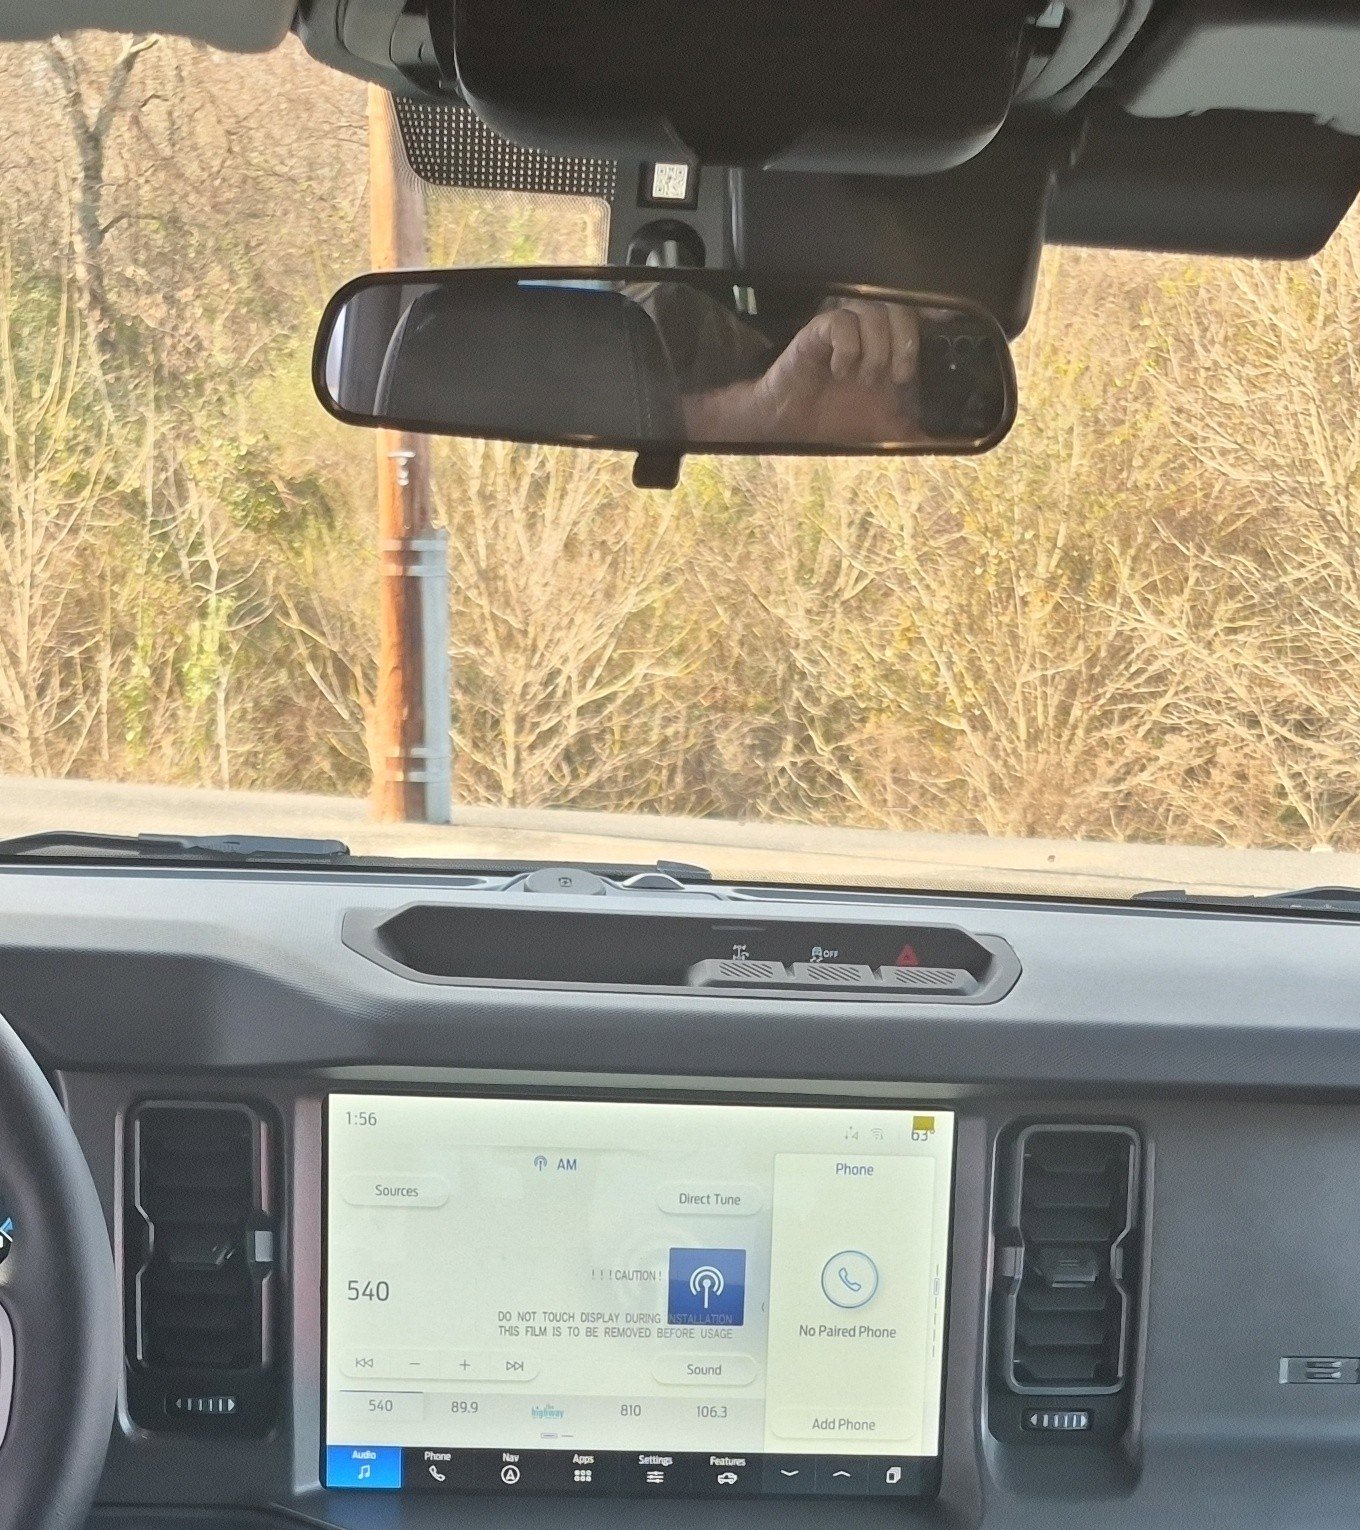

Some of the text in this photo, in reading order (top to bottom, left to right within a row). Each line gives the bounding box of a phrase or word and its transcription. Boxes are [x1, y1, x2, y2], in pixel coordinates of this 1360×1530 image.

[823, 950, 838, 958] OFF
[346, 1111, 377, 1126] 1:56
[557, 1158, 577, 1171] AM
[835, 1163, 874, 1176] Phone
[375, 1184, 419, 1197] Sources
[679, 1192, 741, 1206] Direct Tune
[347, 1279, 390, 1302] 540
[498, 1311, 512, 1323] DO
[517, 1312, 537, 1323] NOT
[542, 1312, 575, 1323] TOUCH
[580, 1312, 620, 1324] DISPLAY
[625, 1313, 661, 1324] DURING
[499, 1326, 733, 1339] THIS FILM IS TO BE REMOVED BEFORE USAGE
[799, 1325, 897, 1338] No Paired Phone
[686, 1363, 722, 1376] Sound
[368, 1400, 393, 1412] 540
[451, 1401, 479, 1413] 89.9
[620, 1405, 642, 1417] 810
[696, 1406, 728, 1418] 106.3
[812, 1418, 876, 1431] Add Phone
[352, 1450, 376, 1460] Audio
[424, 1451, 452, 1462] Phone
[502, 1453, 520, 1463] Nav
[572, 1453, 594, 1466] Apps
[638, 1455, 674, 1467] Settings
[709, 1456, 747, 1467] Features
